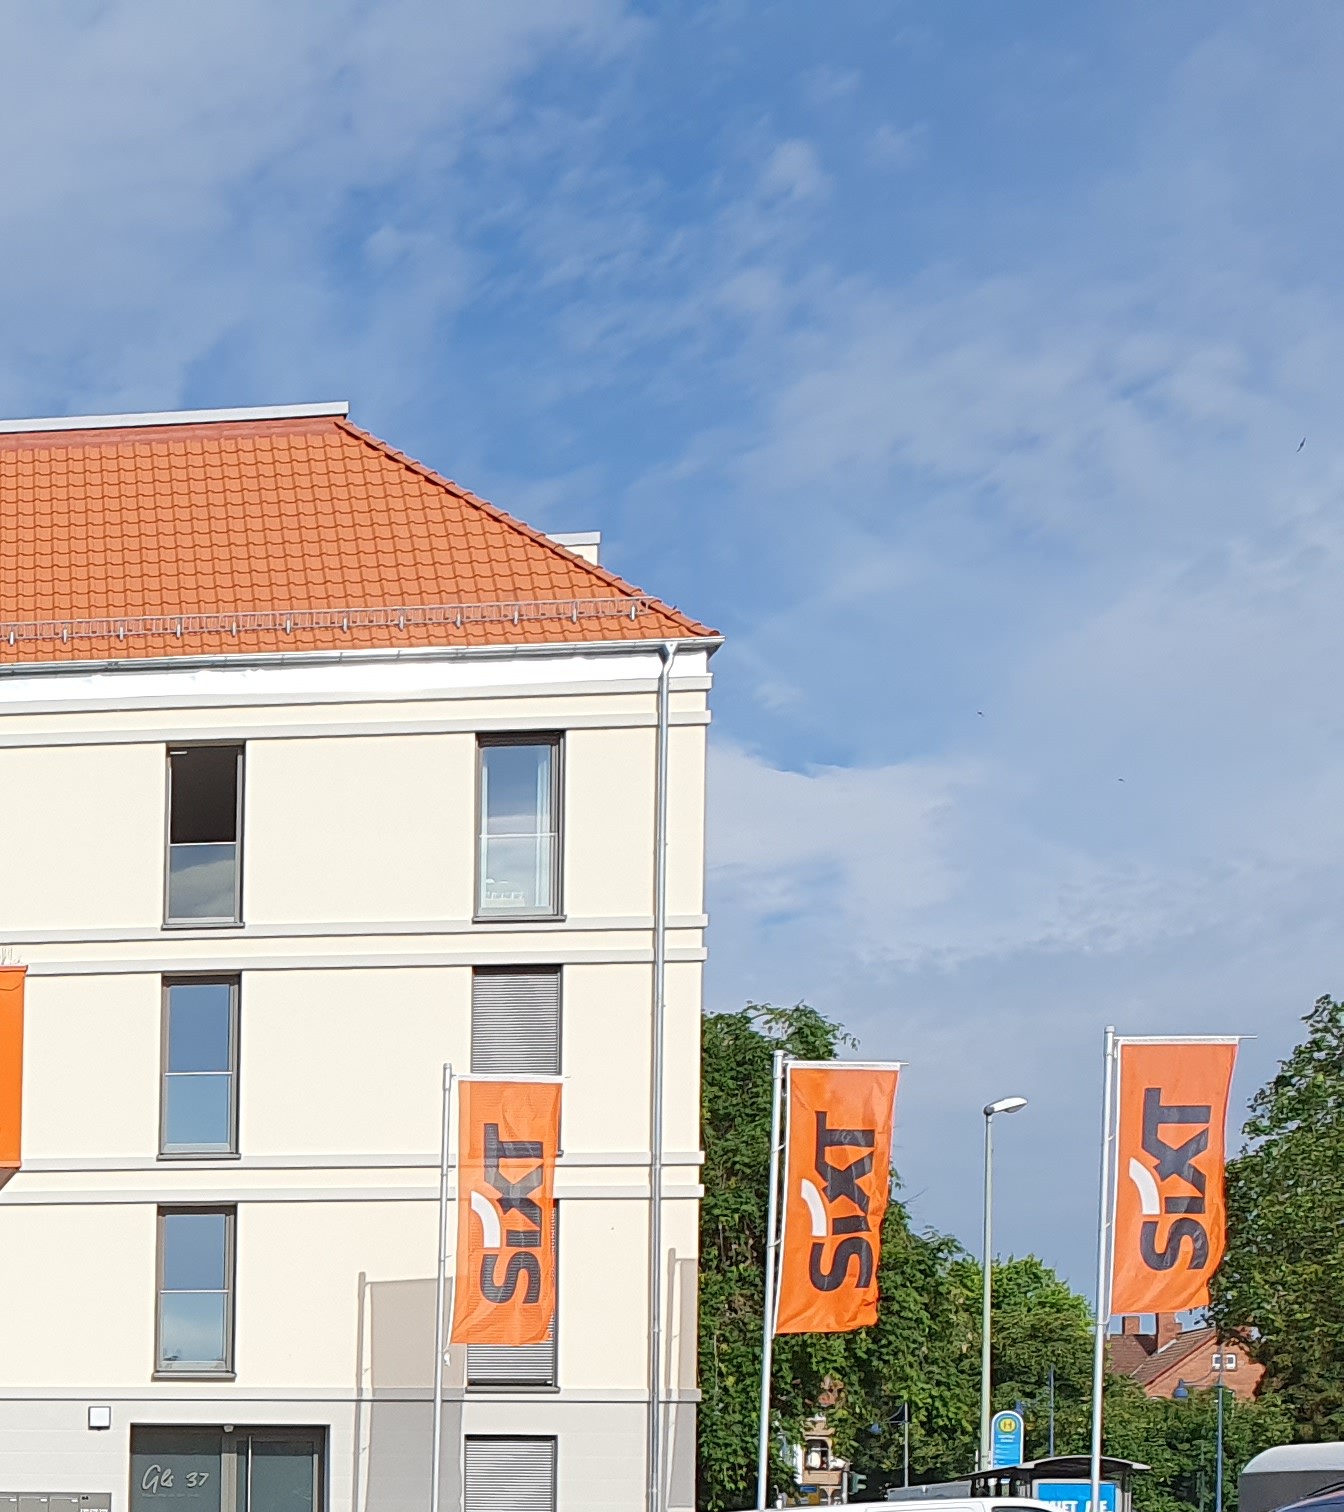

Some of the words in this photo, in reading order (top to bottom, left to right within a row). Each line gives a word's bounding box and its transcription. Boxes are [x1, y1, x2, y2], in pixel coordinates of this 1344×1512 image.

[471, 1122, 544, 1304] SIXT
[800, 1110, 876, 1292] SIXT
[1129, 1086, 1212, 1272] SIXT
[185, 1472, 209, 1487] 37
